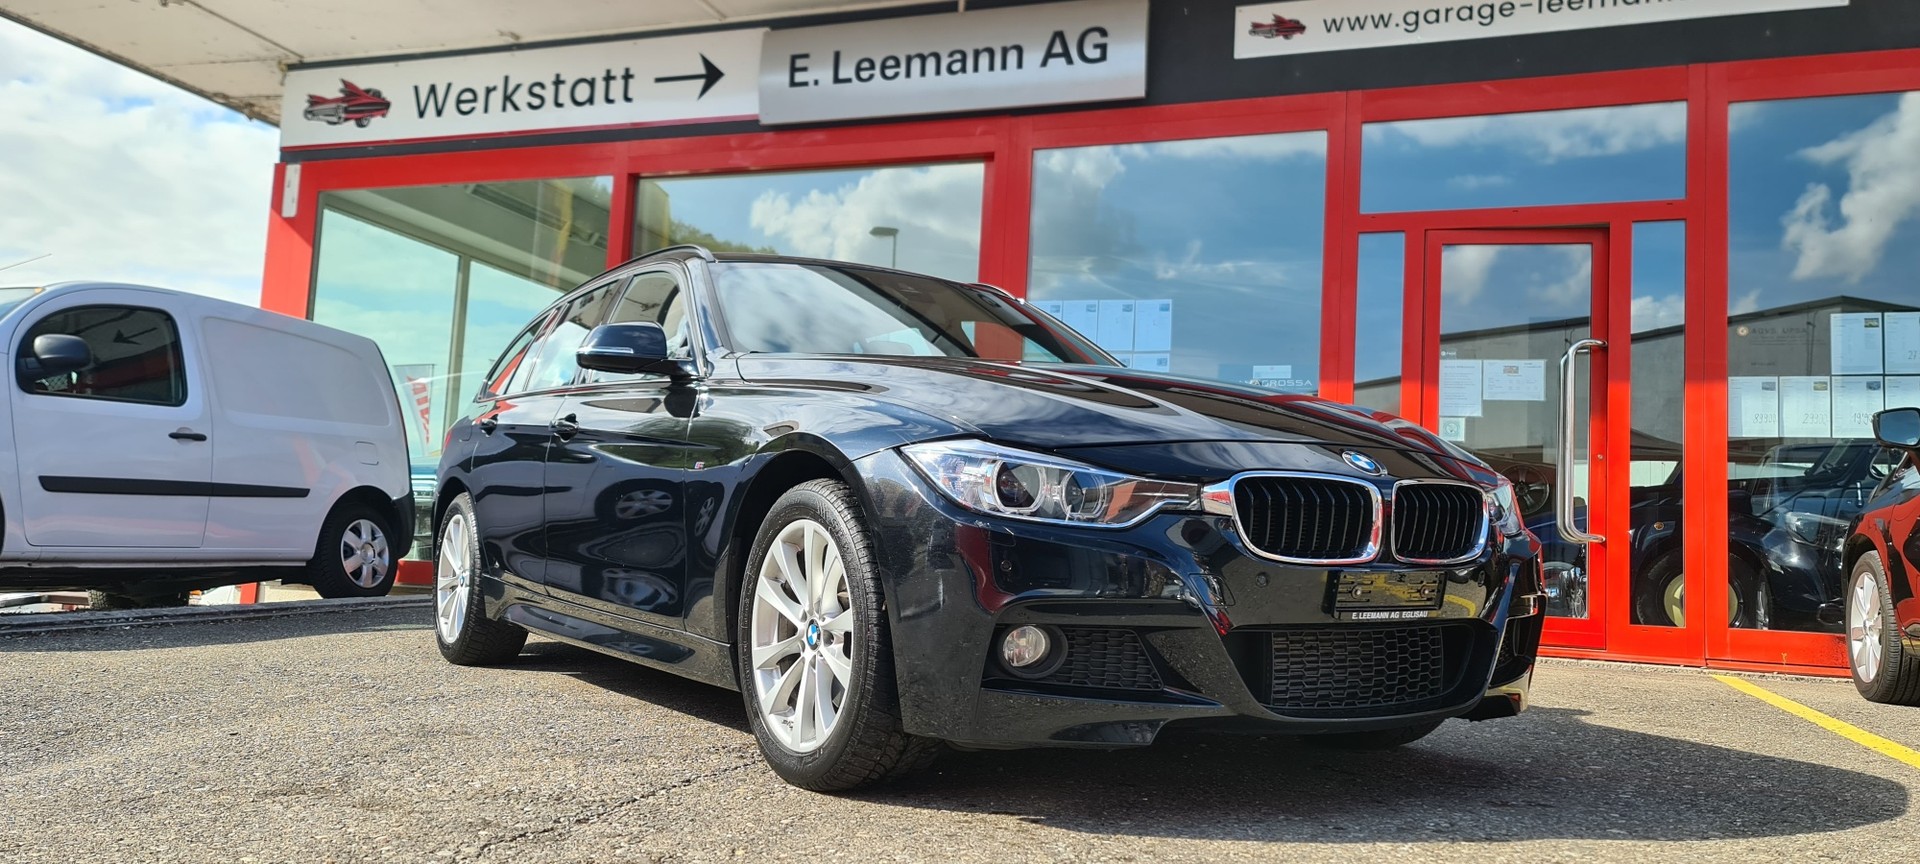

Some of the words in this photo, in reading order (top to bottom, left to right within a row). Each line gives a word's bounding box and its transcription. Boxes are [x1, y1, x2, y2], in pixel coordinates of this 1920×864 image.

[788, 53, 819, 88] E.
[832, 43, 1024, 85] Leemann
[1040, 26, 1109, 68] AG
[413, 67, 635, 119] Werkstatt
[1359, 611, 1390, 620] LEEMANN
[1390, 611, 1400, 619] AG
[1402, 610, 1429, 618] EGLISAU
